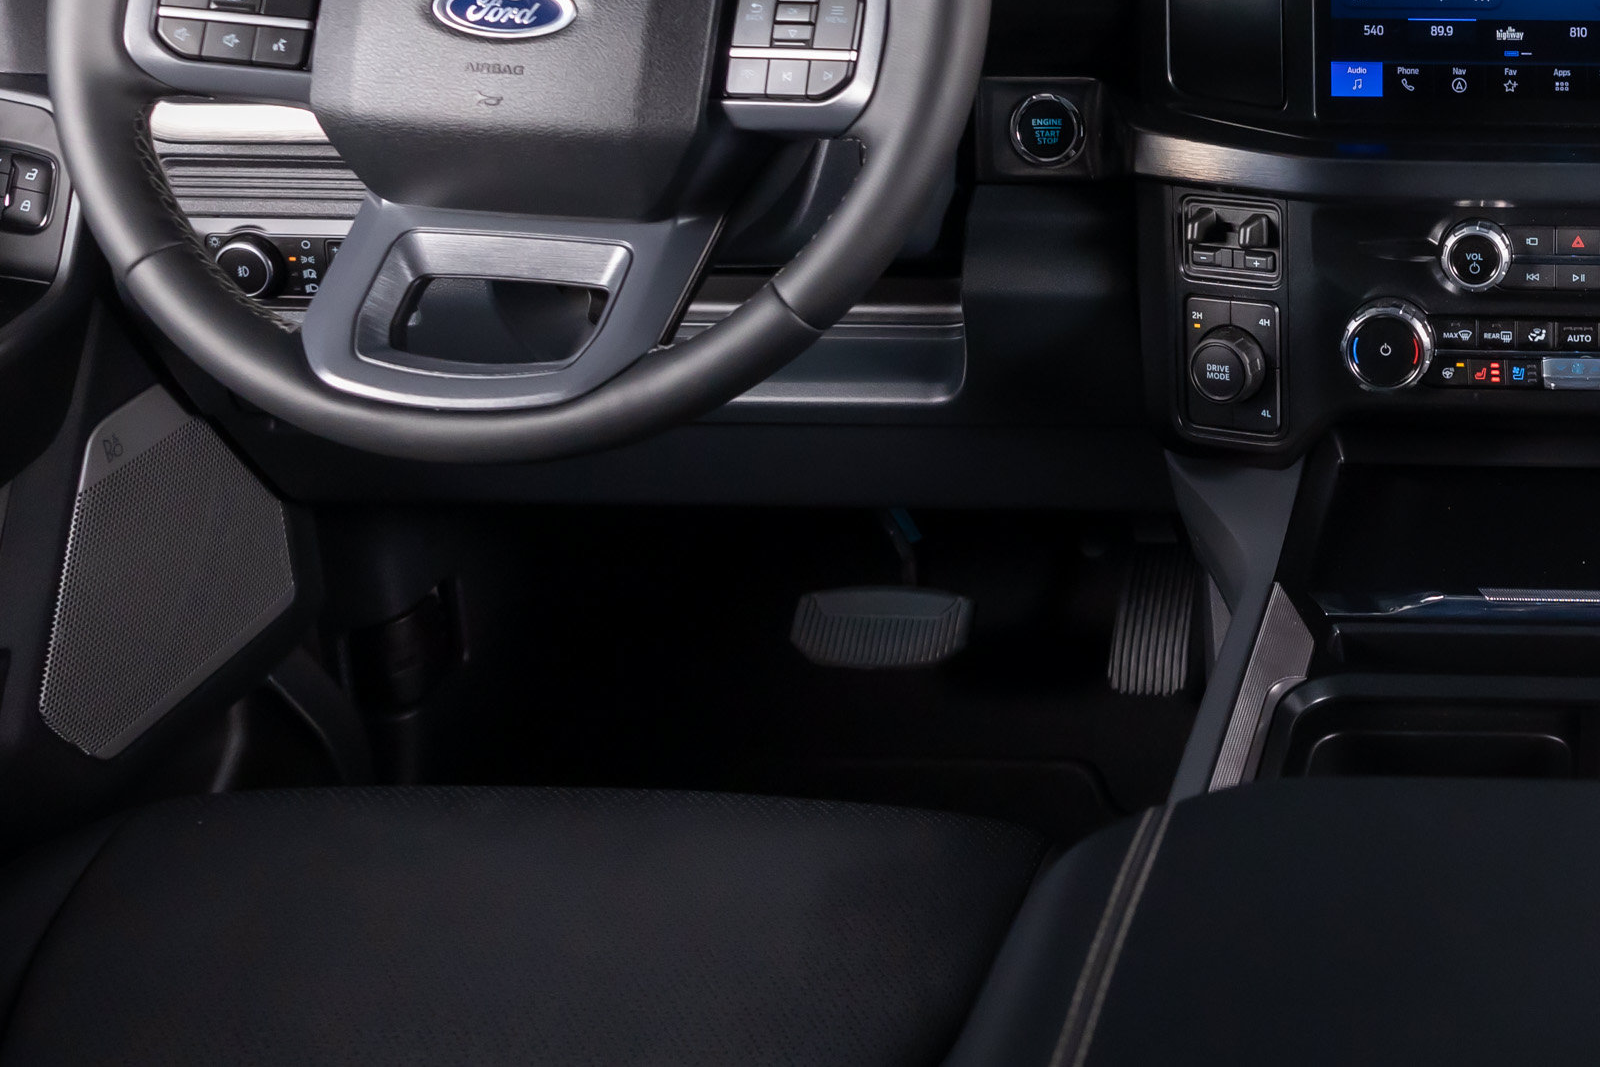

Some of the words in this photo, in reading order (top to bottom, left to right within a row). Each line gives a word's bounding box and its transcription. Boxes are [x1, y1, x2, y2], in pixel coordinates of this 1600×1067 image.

[1363, 25, 1385, 36] 540
[1430, 25, 1454, 37] 89.9
[1569, 26, 1588, 38] 810
[465, 62, 526, 76] AIRBAG
[1347, 66, 1367, 75] Audio
[1397, 66, 1420, 76] Phone
[1452, 67, 1467, 76] Nav
[1504, 68, 1518, 77] Fav
[1553, 68, 1571, 78] Apps
[1031, 118, 1063, 126] ENGINE
[1035, 130, 1060, 138] START
[1465, 253, 1484, 262] VOL
[1192, 311, 1203, 321] 2H
[1258, 318, 1271, 328] 4H
[1567, 335, 1592, 343] AUTO
[1206, 363, 1230, 374] DRIVE
[1206, 372, 1231, 382] MODE
[1260, 409, 1272, 418] 4L
